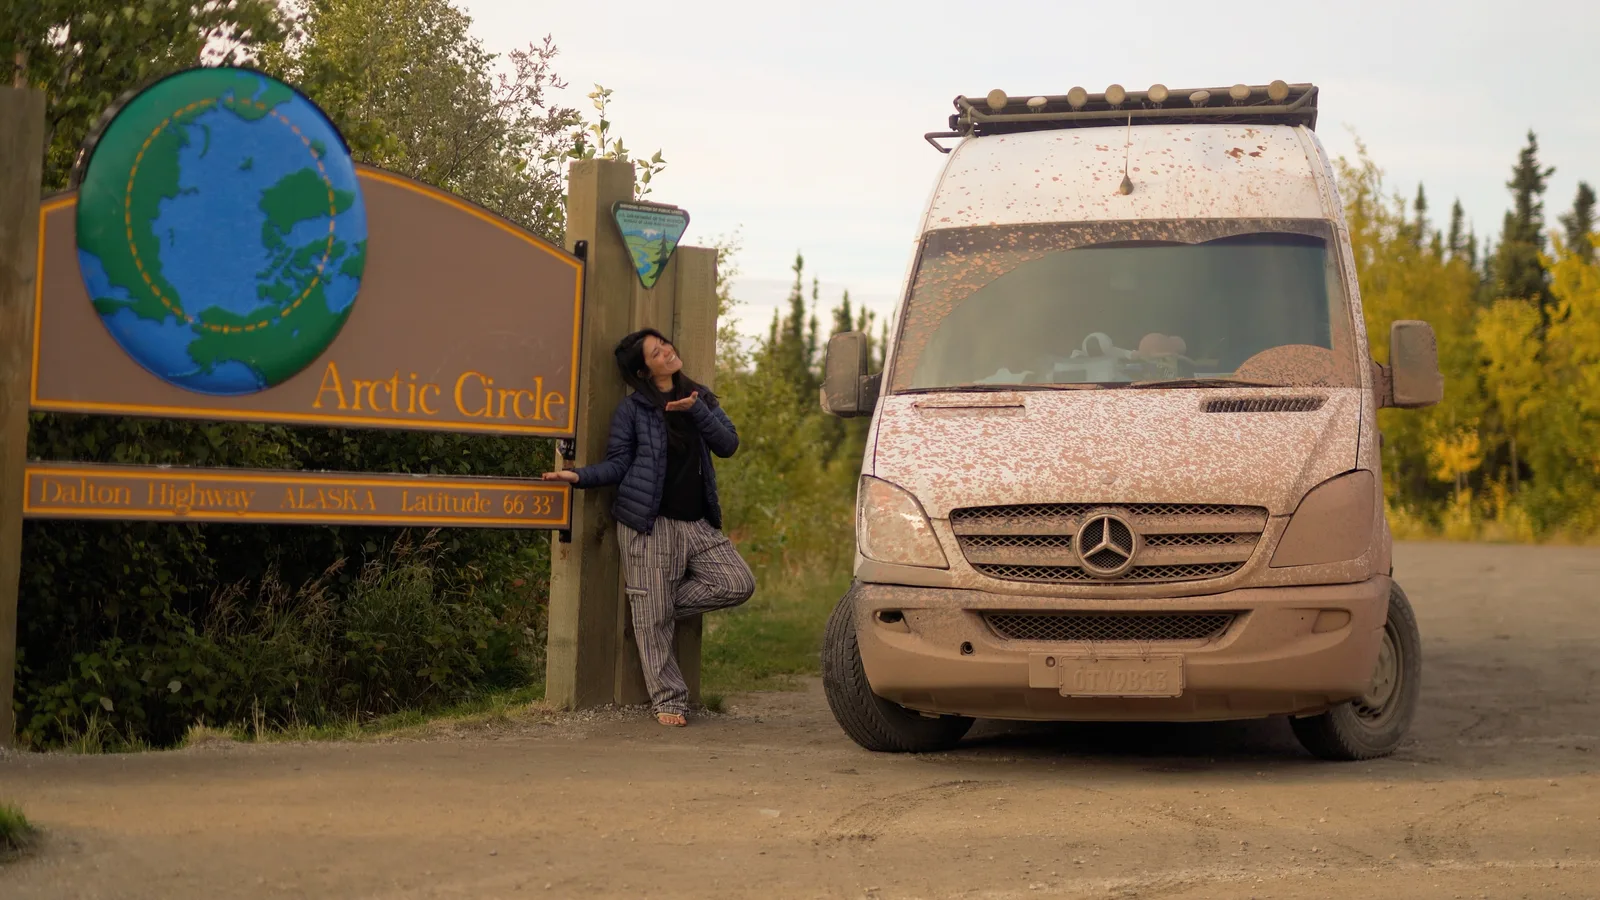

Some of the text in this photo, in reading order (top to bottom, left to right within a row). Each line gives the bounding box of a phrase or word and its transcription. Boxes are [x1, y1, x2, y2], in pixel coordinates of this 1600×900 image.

[312, 360, 565, 421] Arctic Circle
[40, 477, 131, 505] Dalton
[147, 480, 255, 516] Highway
[280, 487, 377, 511] ALASKA
[401, 490, 492, 513] Latitude
